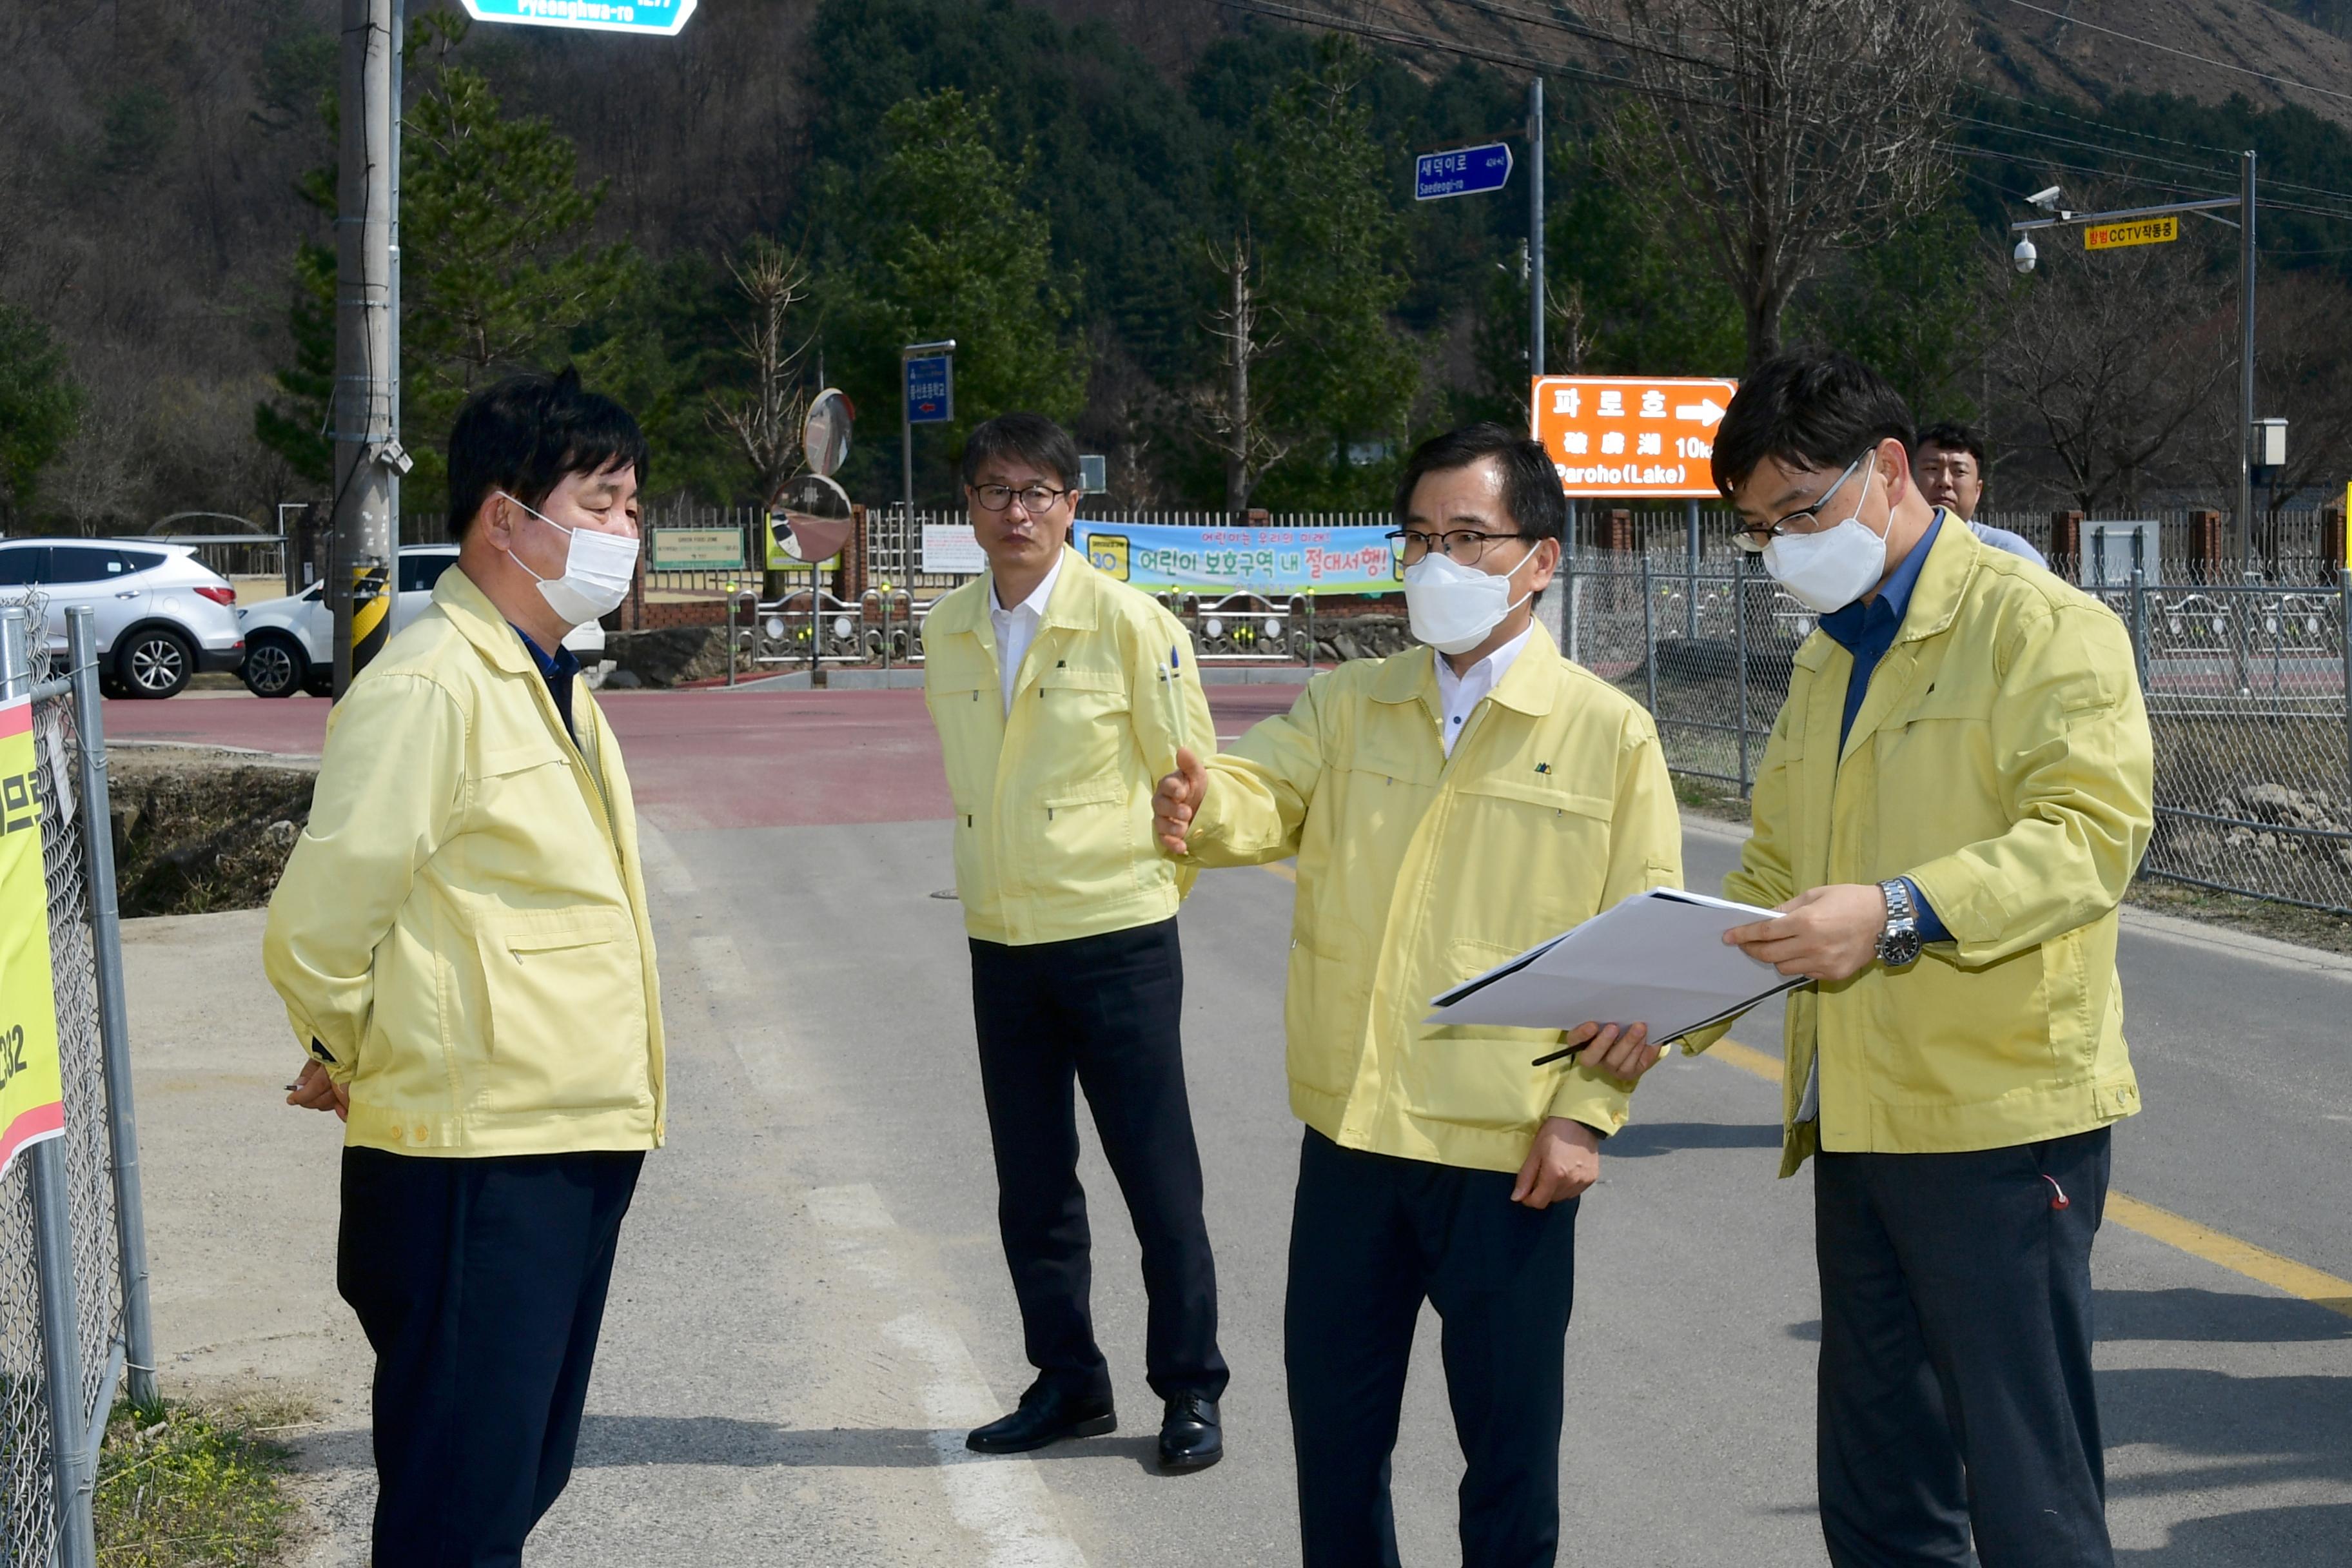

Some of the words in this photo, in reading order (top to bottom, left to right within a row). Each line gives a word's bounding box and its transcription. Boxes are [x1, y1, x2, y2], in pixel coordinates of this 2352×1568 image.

[1420, 155, 1467, 177] 새덕이로
[1202, 531, 1251, 545] 어린이는
[1140, 551, 1197, 576] 어린이
[1205, 551, 1273, 578] 보호구역
[1280, 555, 1298, 571] 내
[1305, 548, 1387, 578] 절대서행!
